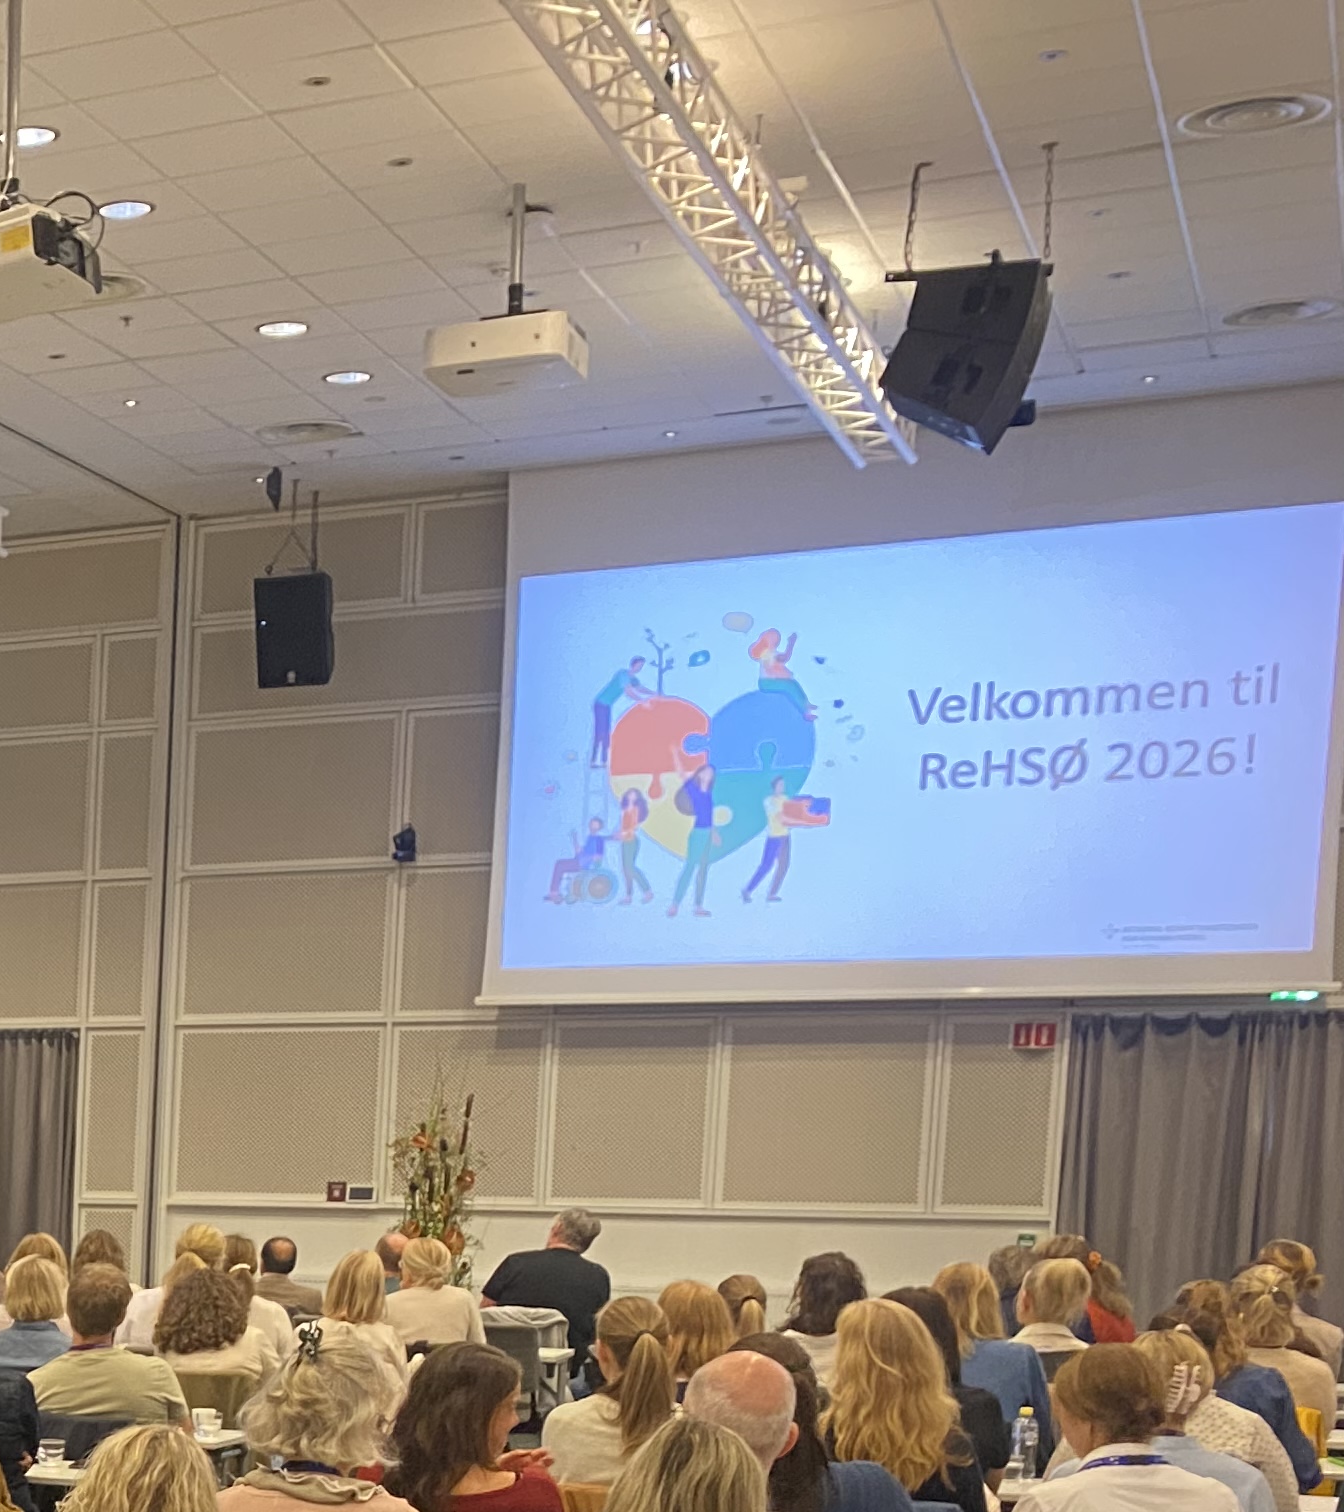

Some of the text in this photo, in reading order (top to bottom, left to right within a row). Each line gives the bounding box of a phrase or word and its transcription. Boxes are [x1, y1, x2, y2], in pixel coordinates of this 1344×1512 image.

[908, 661, 1281, 726] Velkommen til
[918, 732, 1257, 791] ReHSØ 2026!
